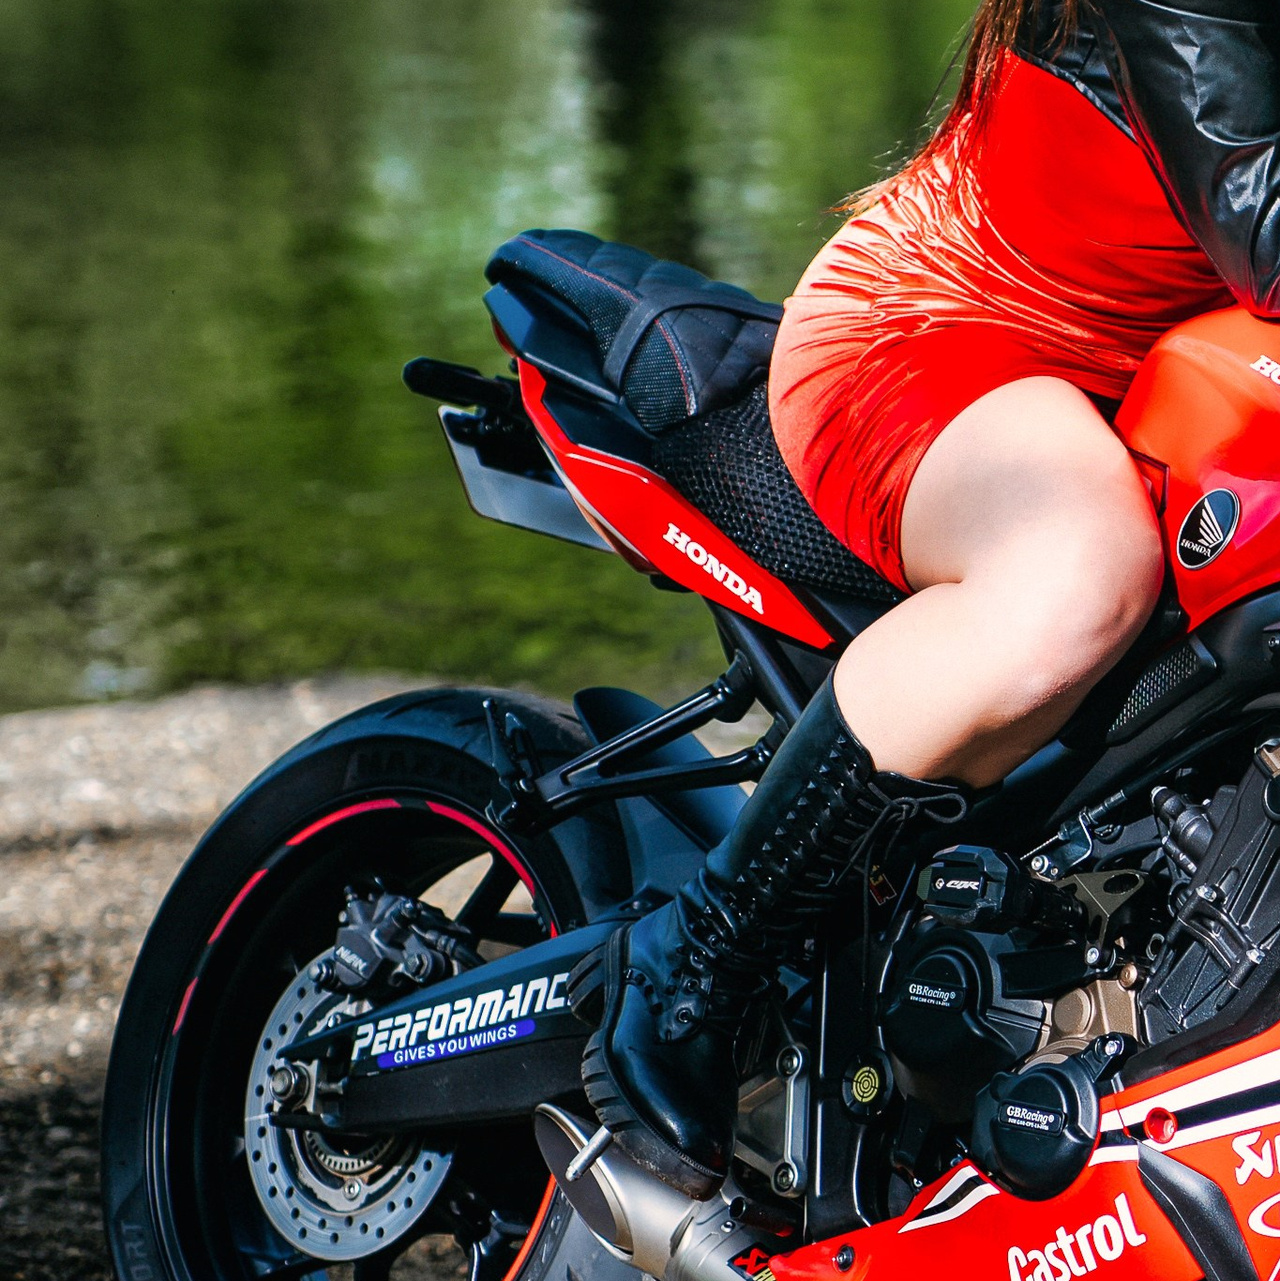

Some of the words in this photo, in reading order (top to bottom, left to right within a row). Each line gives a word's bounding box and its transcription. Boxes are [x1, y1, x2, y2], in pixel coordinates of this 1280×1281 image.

[662, 522, 764, 615] HONDA
[1180, 538, 1212, 558] HONDA
[351, 972, 572, 1061] PERFORMANC
[394, 1043, 436, 1064] GIVES
[438, 1037, 468, 1055] YOU
[469, 1024, 518, 1048] WINGS
